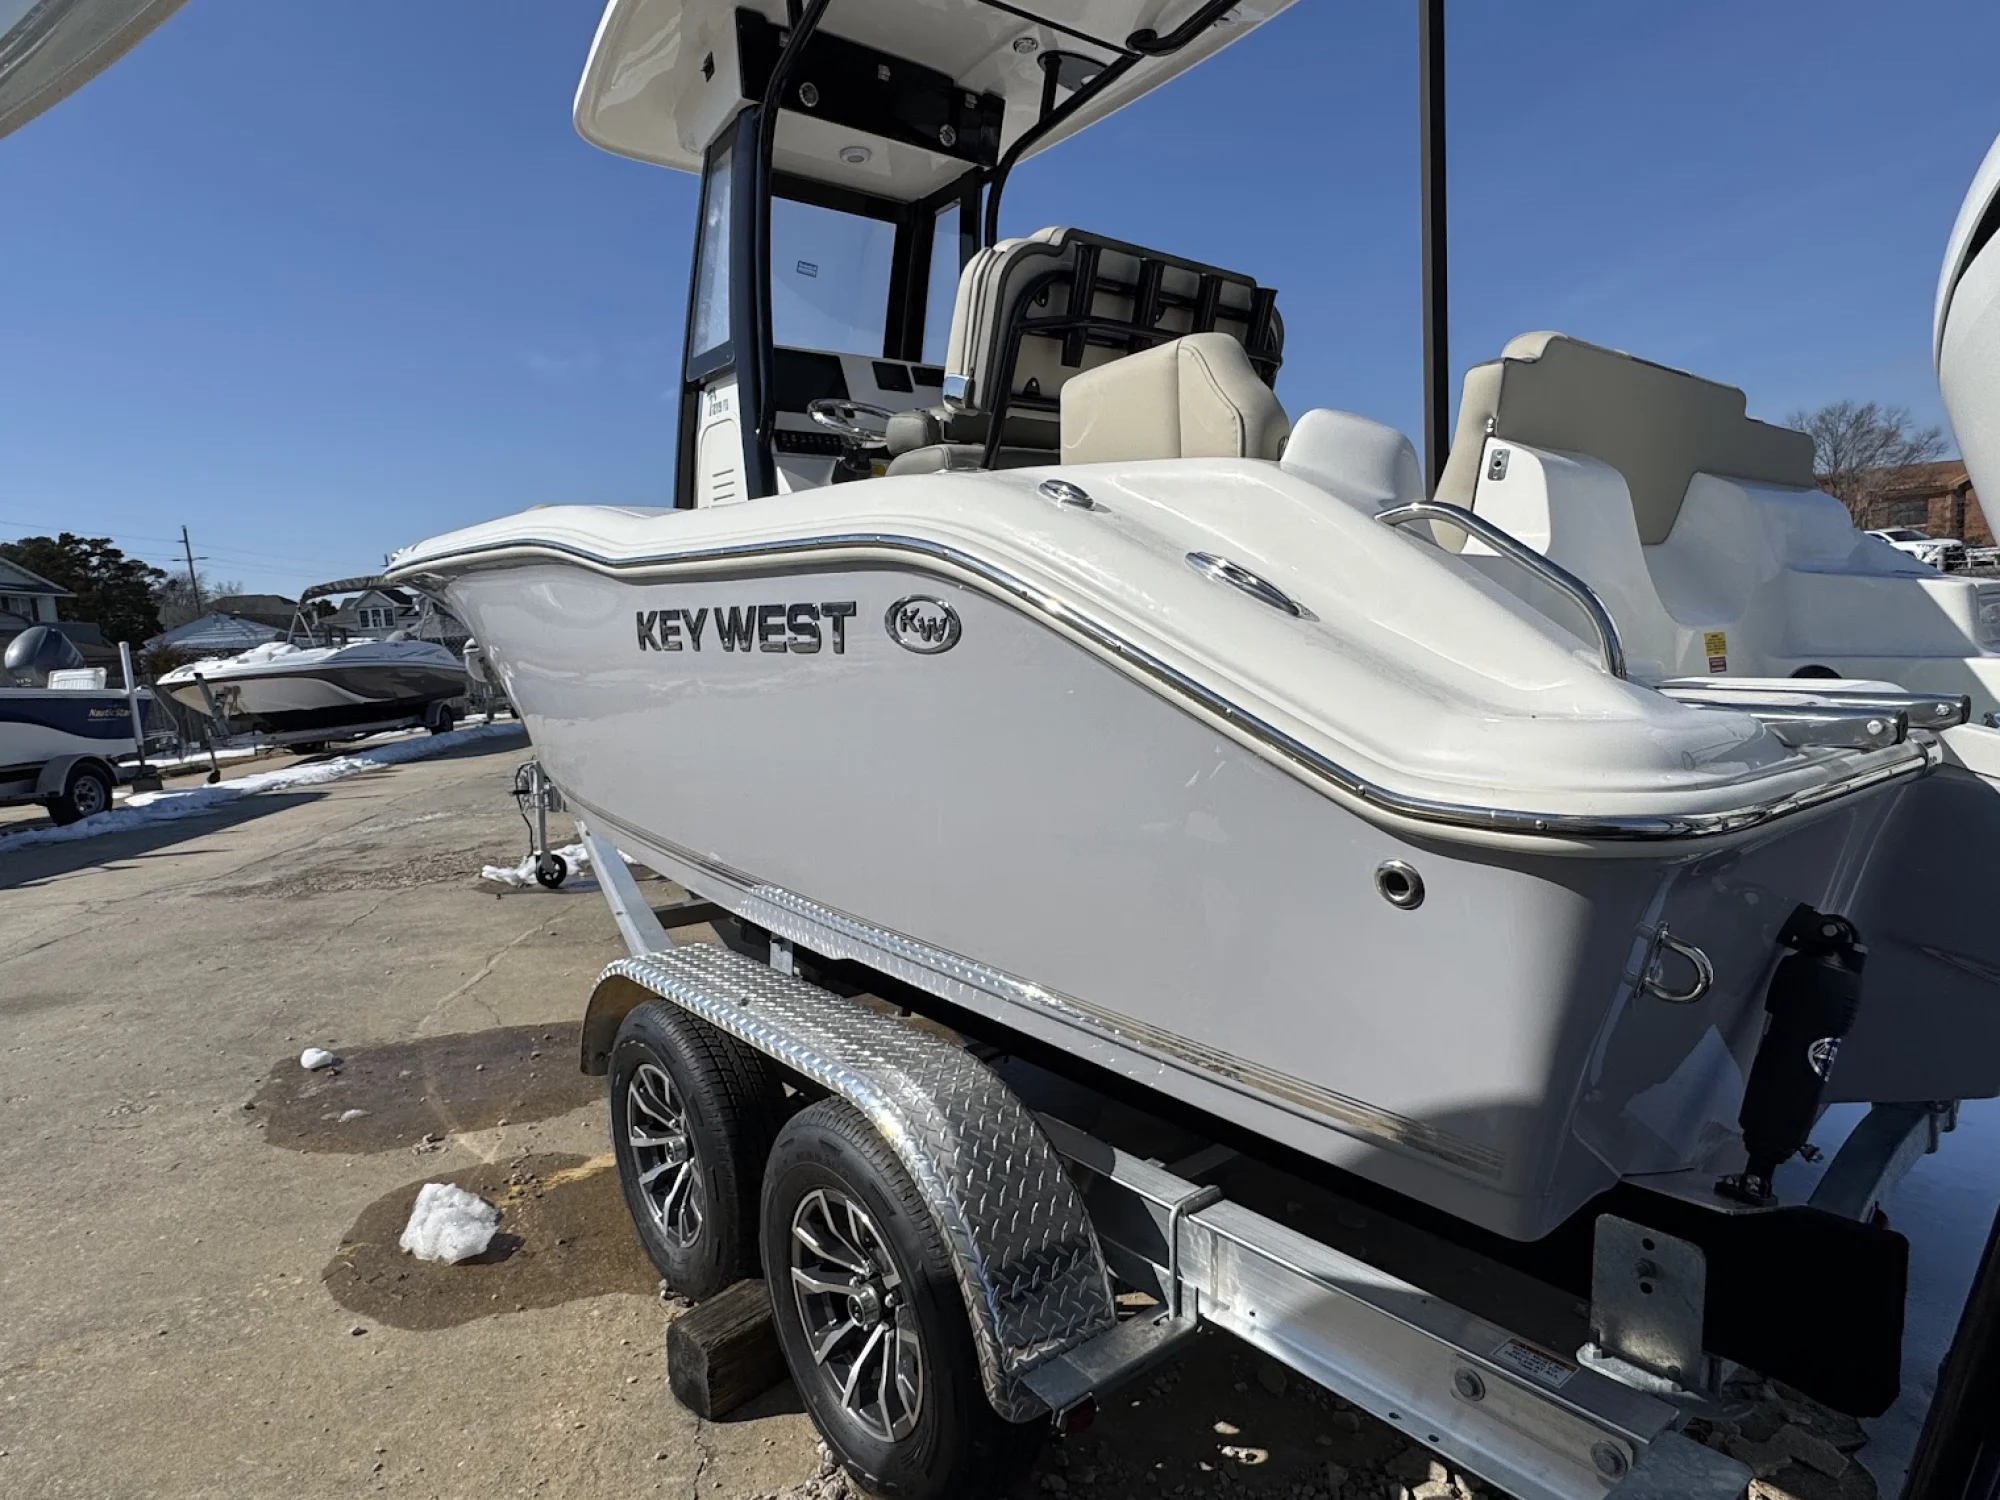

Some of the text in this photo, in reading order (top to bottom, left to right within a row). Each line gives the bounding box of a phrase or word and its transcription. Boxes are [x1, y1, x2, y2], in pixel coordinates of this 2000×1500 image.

[636, 602, 856, 654] KEY WEST
[900, 607, 948, 642] KW
